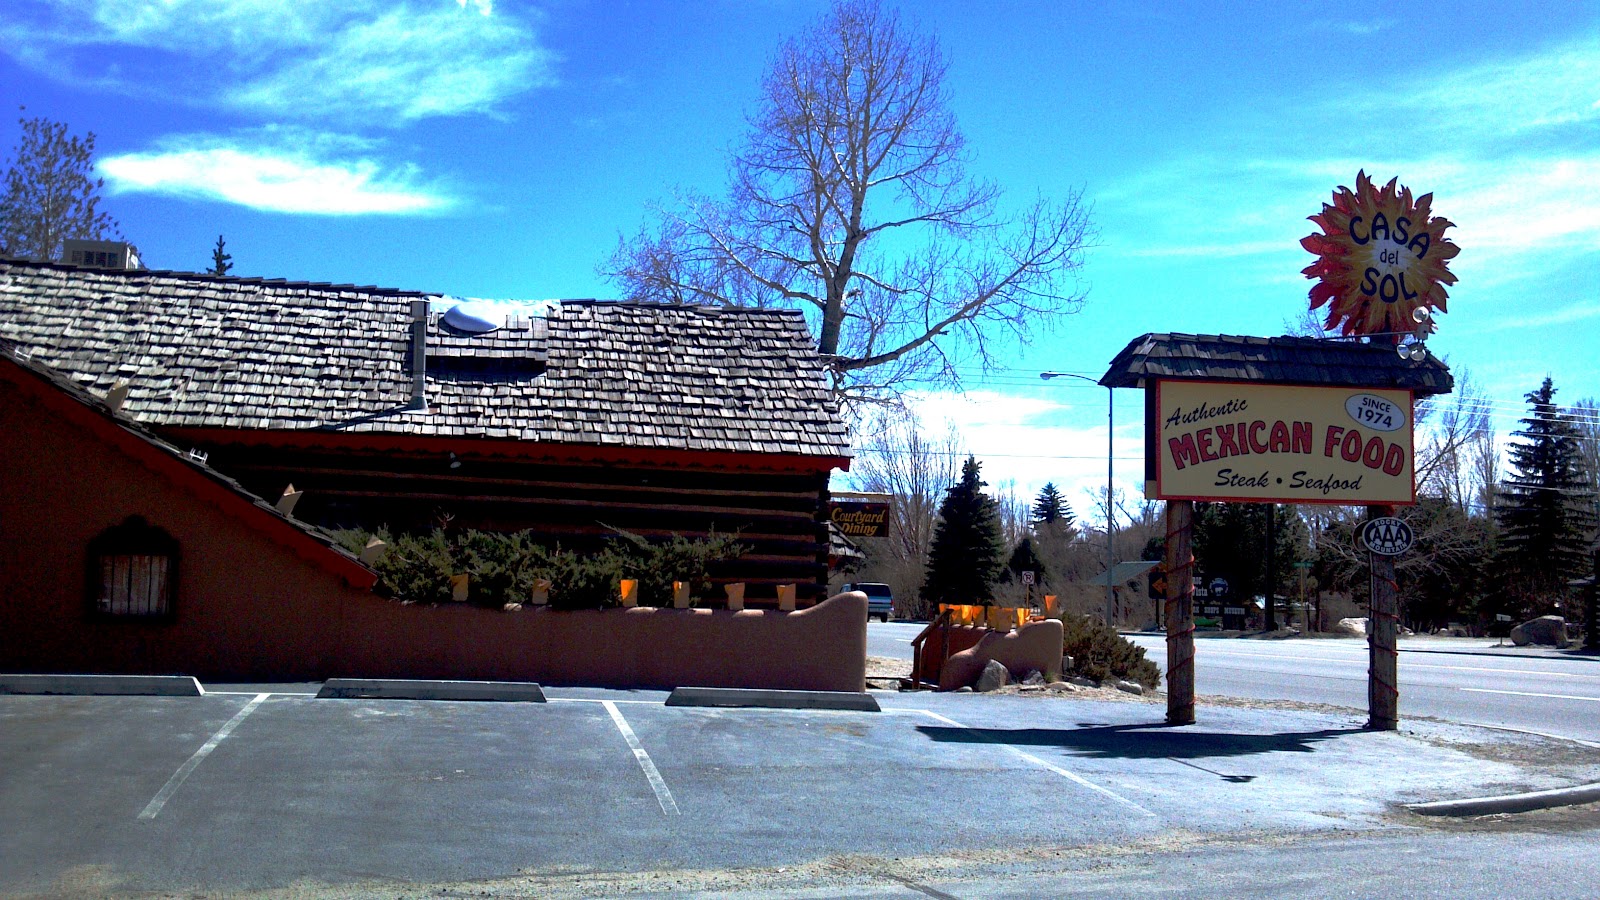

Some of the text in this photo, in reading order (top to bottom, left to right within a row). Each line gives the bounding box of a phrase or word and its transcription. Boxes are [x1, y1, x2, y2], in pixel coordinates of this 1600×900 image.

[1349, 212, 1430, 260] CASA
[1380, 249, 1399, 265] del
[1360, 267, 1418, 303] SOL
[1165, 398, 1248, 430] Authentic
[1361, 397, 1391, 413] SINCE
[1357, 407, 1392, 428] 1974
[1168, 420, 1405, 477] MEXICAN FOOD
[1214, 468, 1363, 495] Steak Seafood
[831, 507, 886, 524] Courtyard
[1374, 519, 1402, 527] ROCKY
[842, 522, 879, 536] Dining
[1372, 524, 1406, 547] AAA
[1369, 541, 1408, 553] MOUNTAIN
